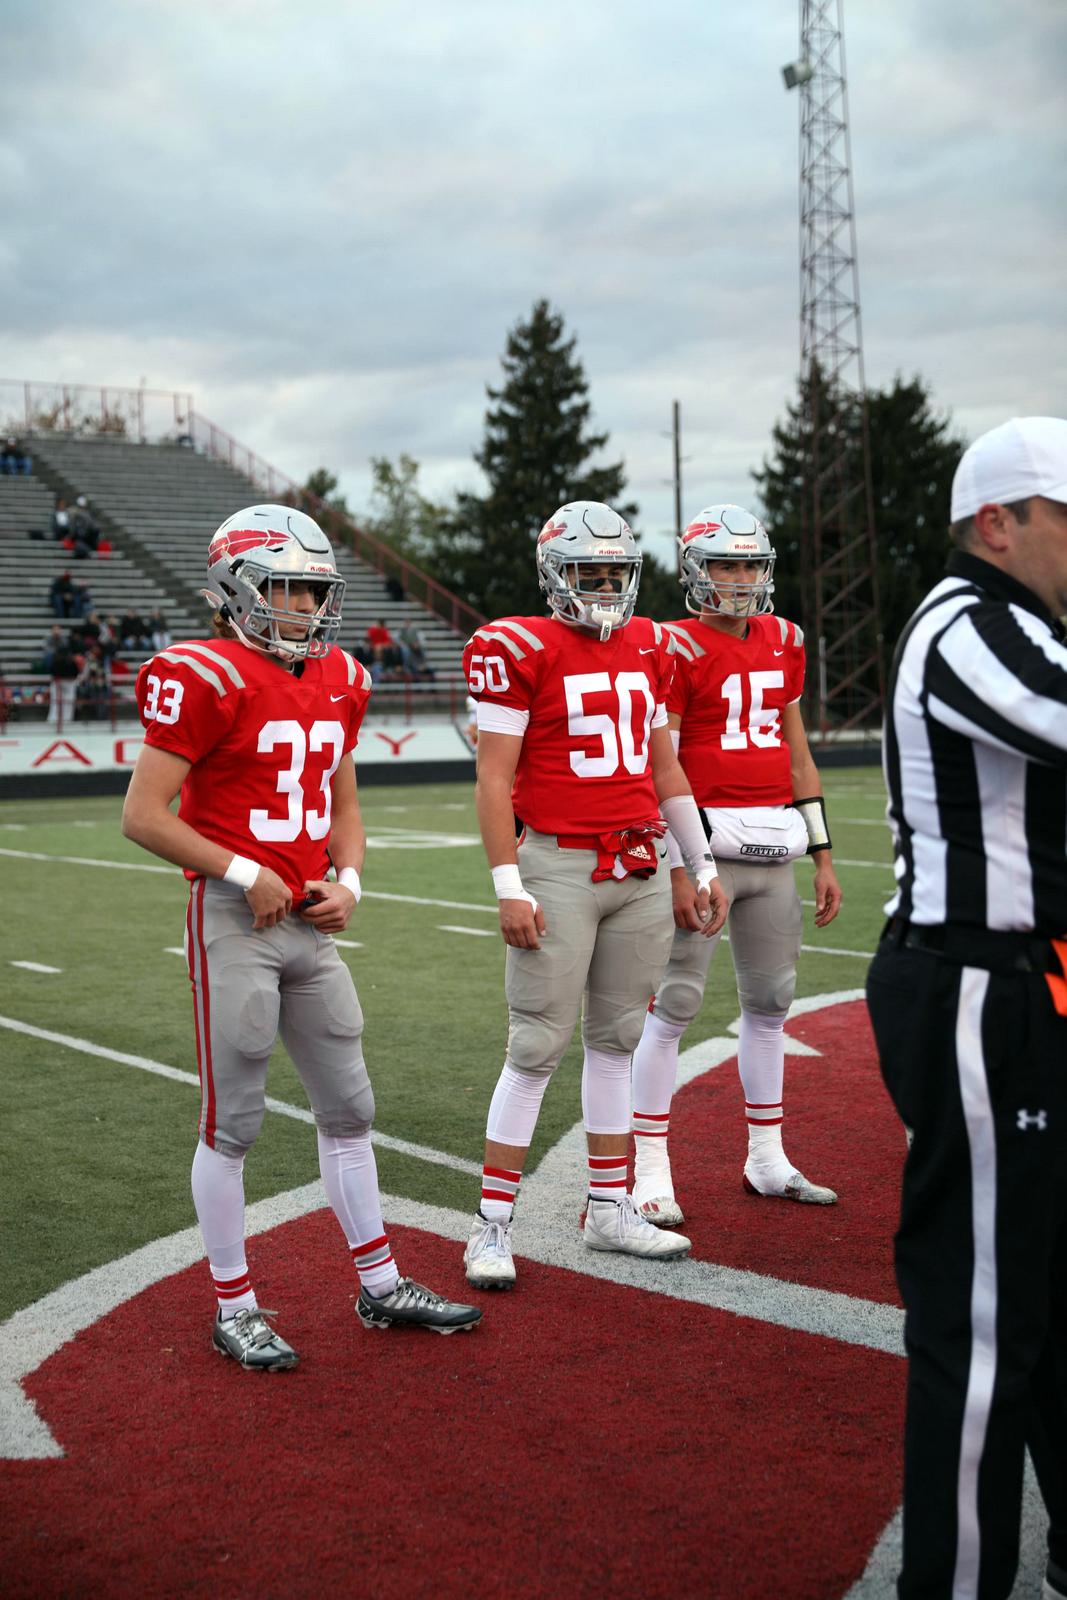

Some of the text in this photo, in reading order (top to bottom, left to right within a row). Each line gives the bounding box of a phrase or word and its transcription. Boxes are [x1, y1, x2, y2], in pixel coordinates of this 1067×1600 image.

[143, 674, 184, 725] 33
[469, 654, 510, 693] 50
[563, 671, 656, 778] 50
[720, 669, 785, 750] 15
[248, 719, 346, 842] 33
[744, 845, 785, 856] BATTLE
